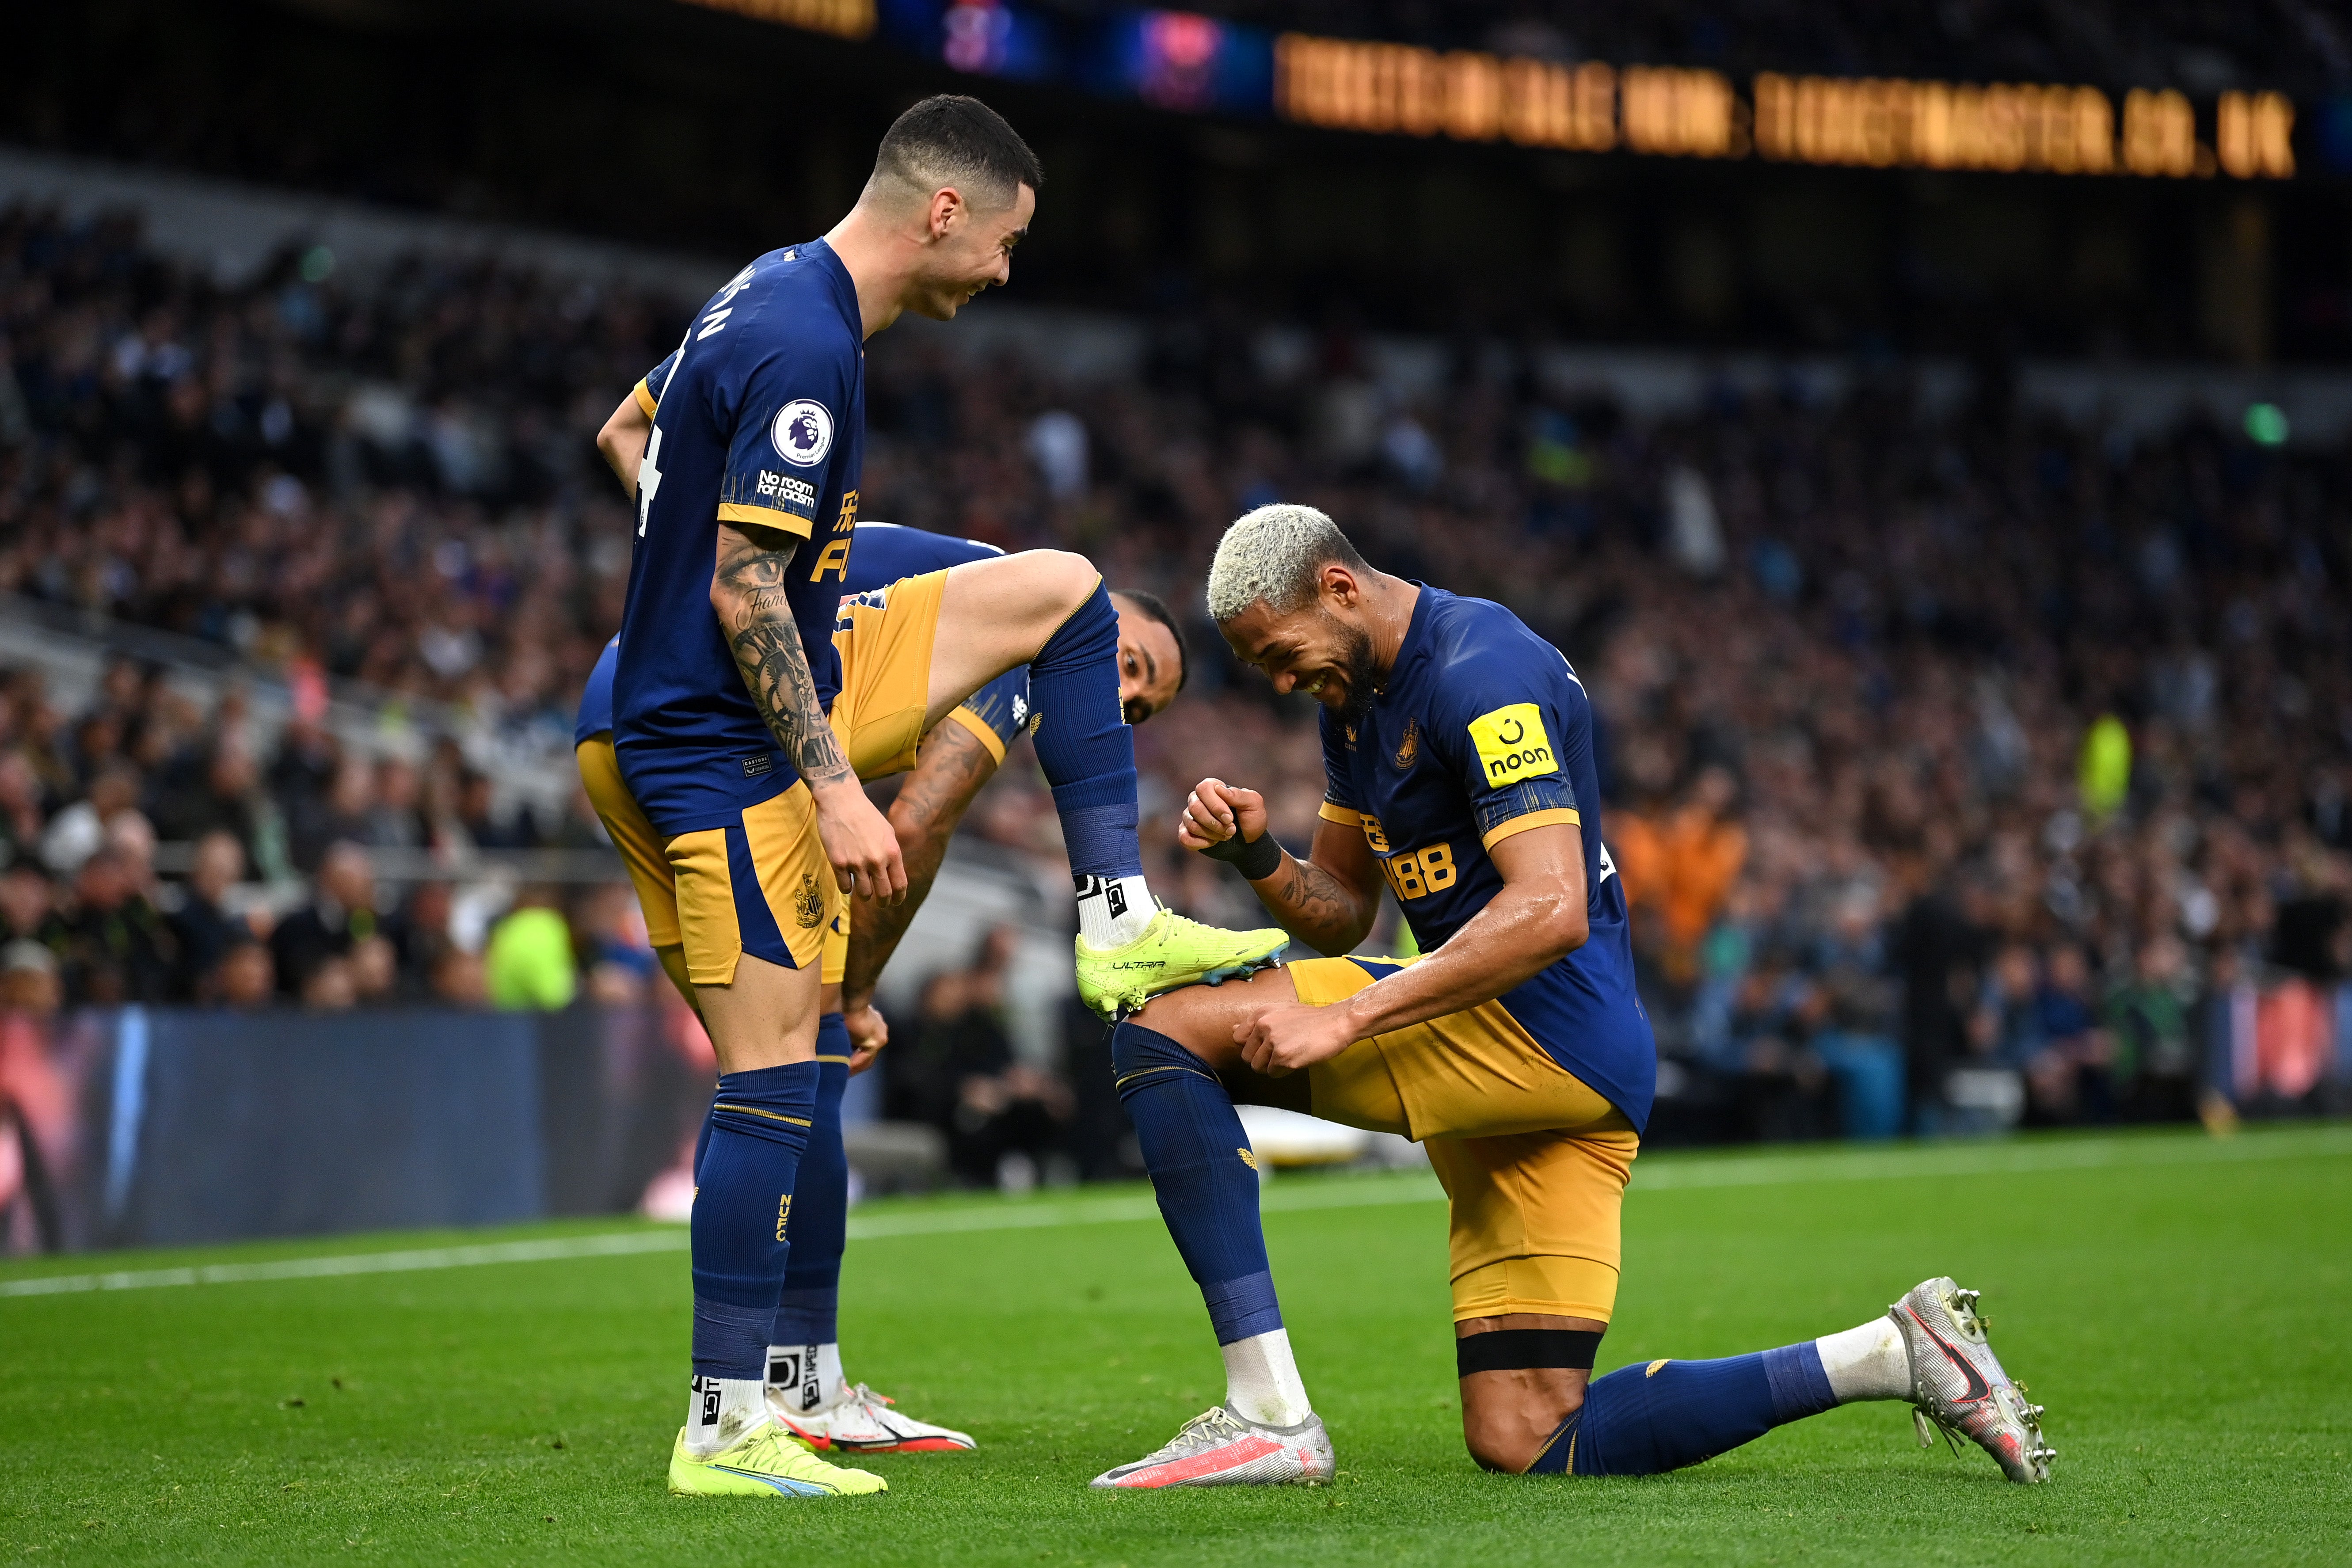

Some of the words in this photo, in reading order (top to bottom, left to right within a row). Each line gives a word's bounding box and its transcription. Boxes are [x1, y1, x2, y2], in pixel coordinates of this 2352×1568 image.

[814, 436, 826, 454] League
[759, 469, 780, 485] No
[780, 476, 813, 496] room
[777, 487, 814, 508] racism
[744, 756, 768, 766] CASTORE
[1489, 747, 1549, 777] noon
[1113, 961, 1166, 969] ULTRA
[776, 1194, 792, 1242] NUFC
